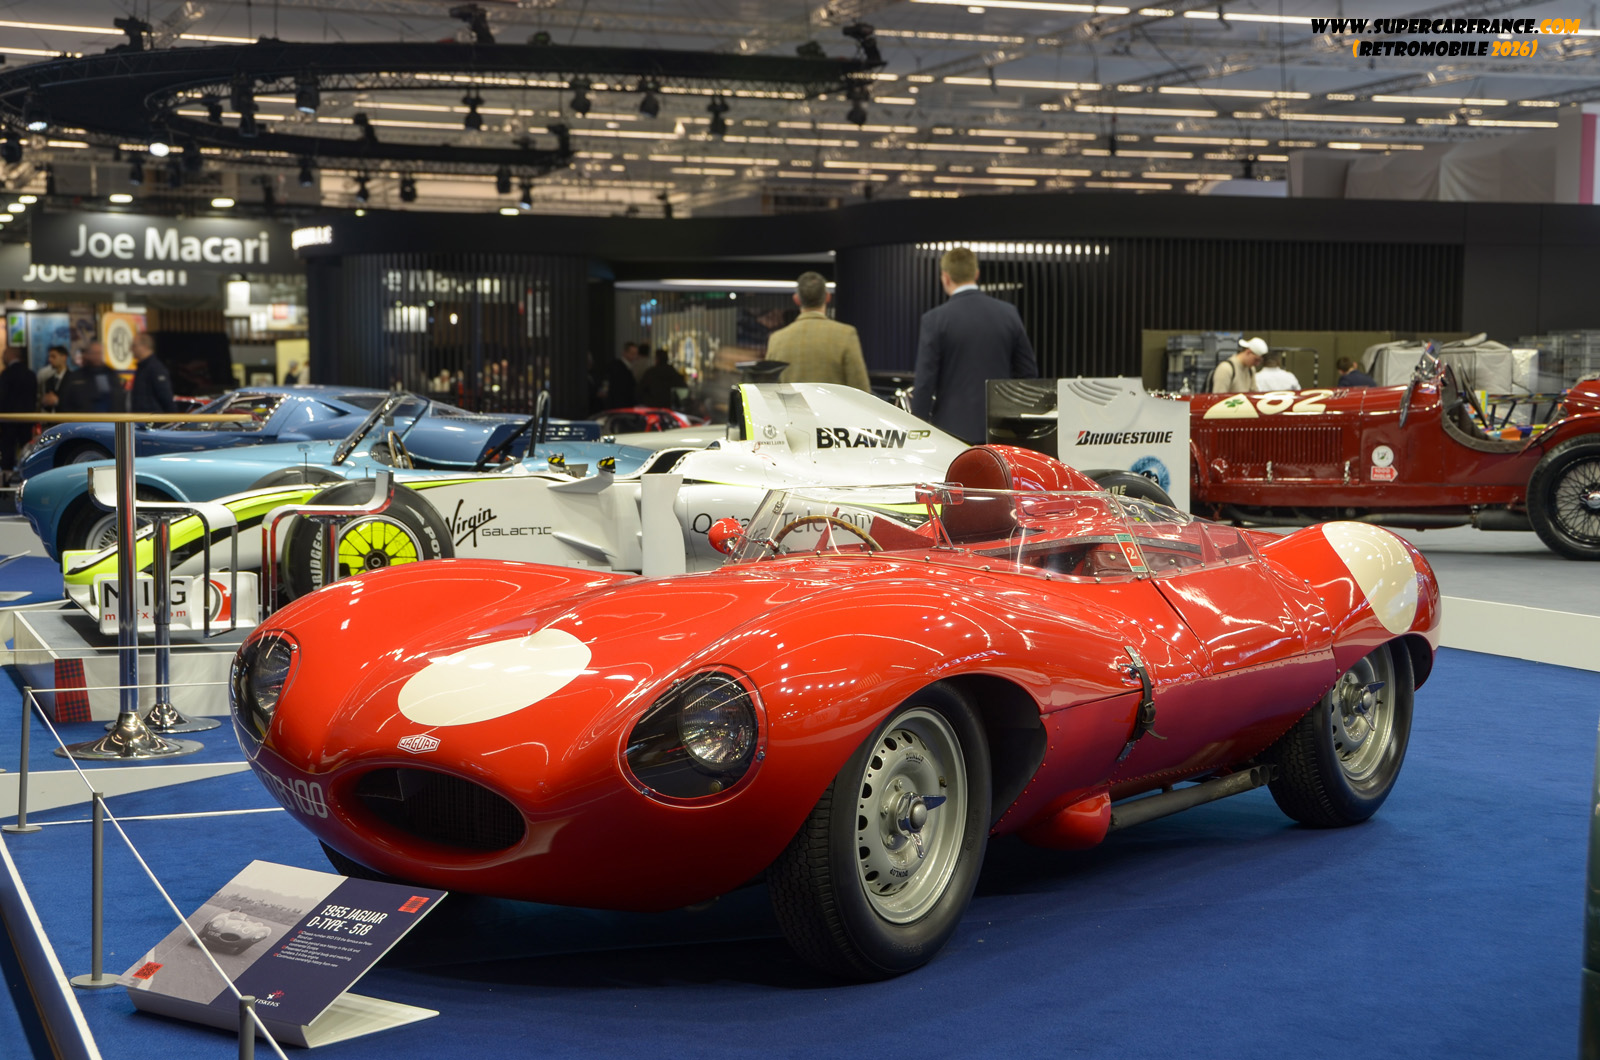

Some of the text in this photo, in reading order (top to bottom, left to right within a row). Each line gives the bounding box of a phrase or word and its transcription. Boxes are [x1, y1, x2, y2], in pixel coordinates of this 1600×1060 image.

[70, 224, 135, 260] Joe
[145, 227, 269, 264] Macari
[1256, 389, 1334, 416] 82
[816, 427, 907, 449] BRAWN
[1075, 430, 1174, 446] BRIDGESTONE
[445, 499, 497, 548] Virgin
[1126, 546, 1138, 560] 2
[400, 737, 438, 750] JAGUAR
[320, 904, 389, 925] 1955 JAGUAR
[306, 916, 348, 932] D-TYPE
[348, 923, 373, 936] 518
